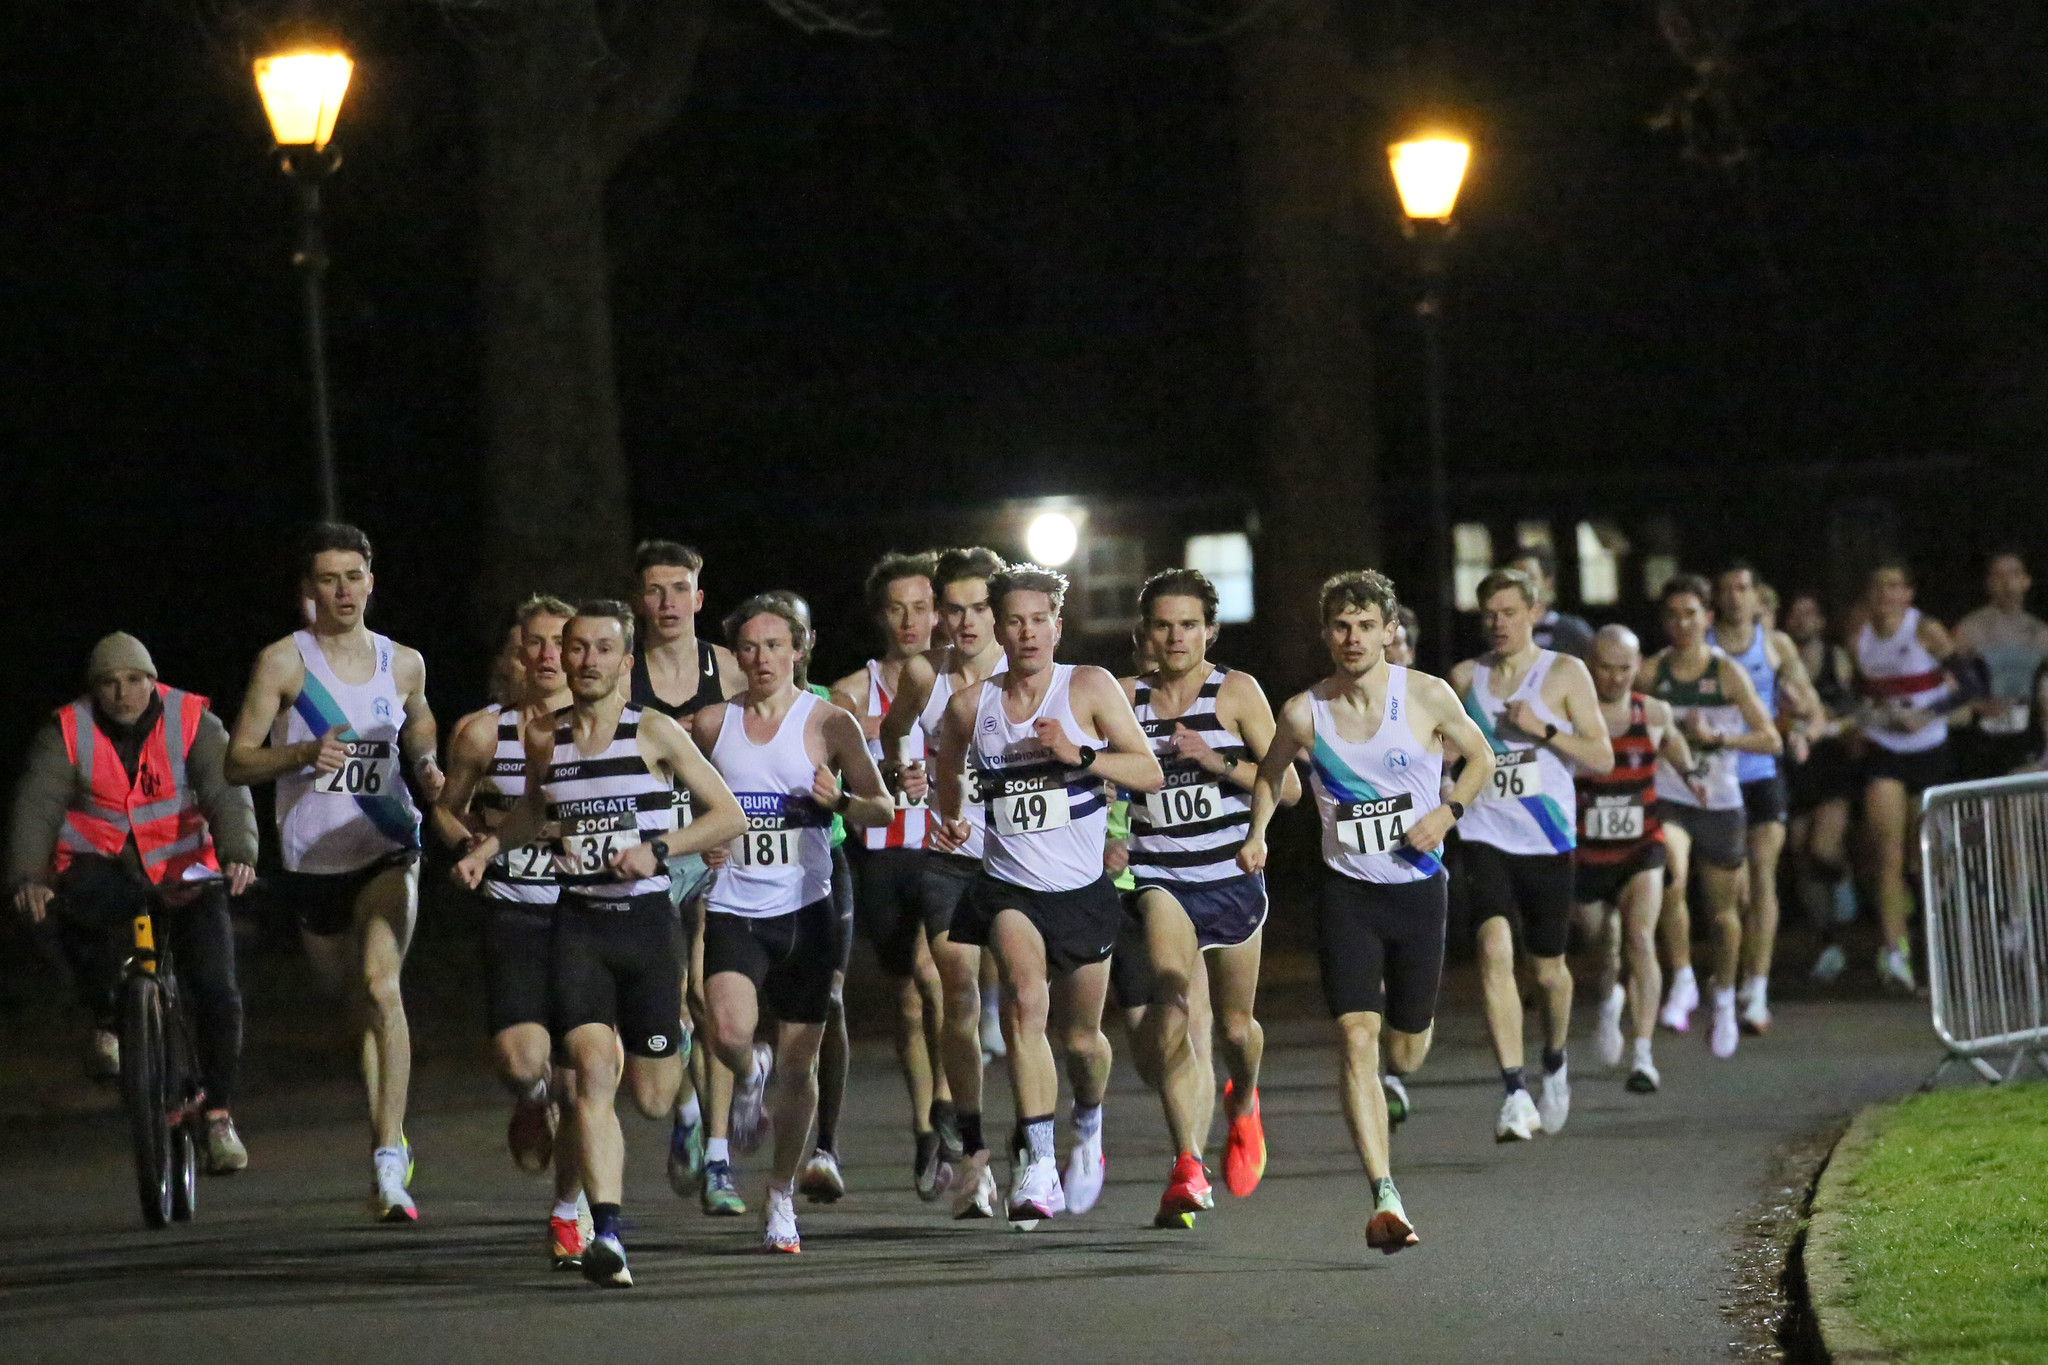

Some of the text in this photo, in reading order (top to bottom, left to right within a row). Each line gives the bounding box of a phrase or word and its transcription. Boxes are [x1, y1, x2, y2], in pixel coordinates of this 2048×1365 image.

[1390, 696, 1398, 721] soar
[1140, 723, 1159, 733] ar
[346, 742, 379, 755] oar
[1496, 751, 1524, 766] oar
[327, 759, 381, 794] 206
[496, 763, 526, 772] soar
[554, 766, 581, 778] soar
[1004, 776, 1048, 794] soar
[1163, 771, 1201, 787] oar
[1493, 768, 1524, 798] 96
[557, 797, 638, 819] HIGHGATE
[735, 795, 780, 810] TBURY
[1012, 794, 1047, 831] 49
[1161, 787, 1211, 824] 106
[1352, 798, 1397, 818] soar
[576, 816, 620, 834] soar
[1597, 809, 1635, 834] 186
[1355, 814, 1406, 854] 114
[581, 835, 619, 870] 36
[743, 833, 788, 866] 181
